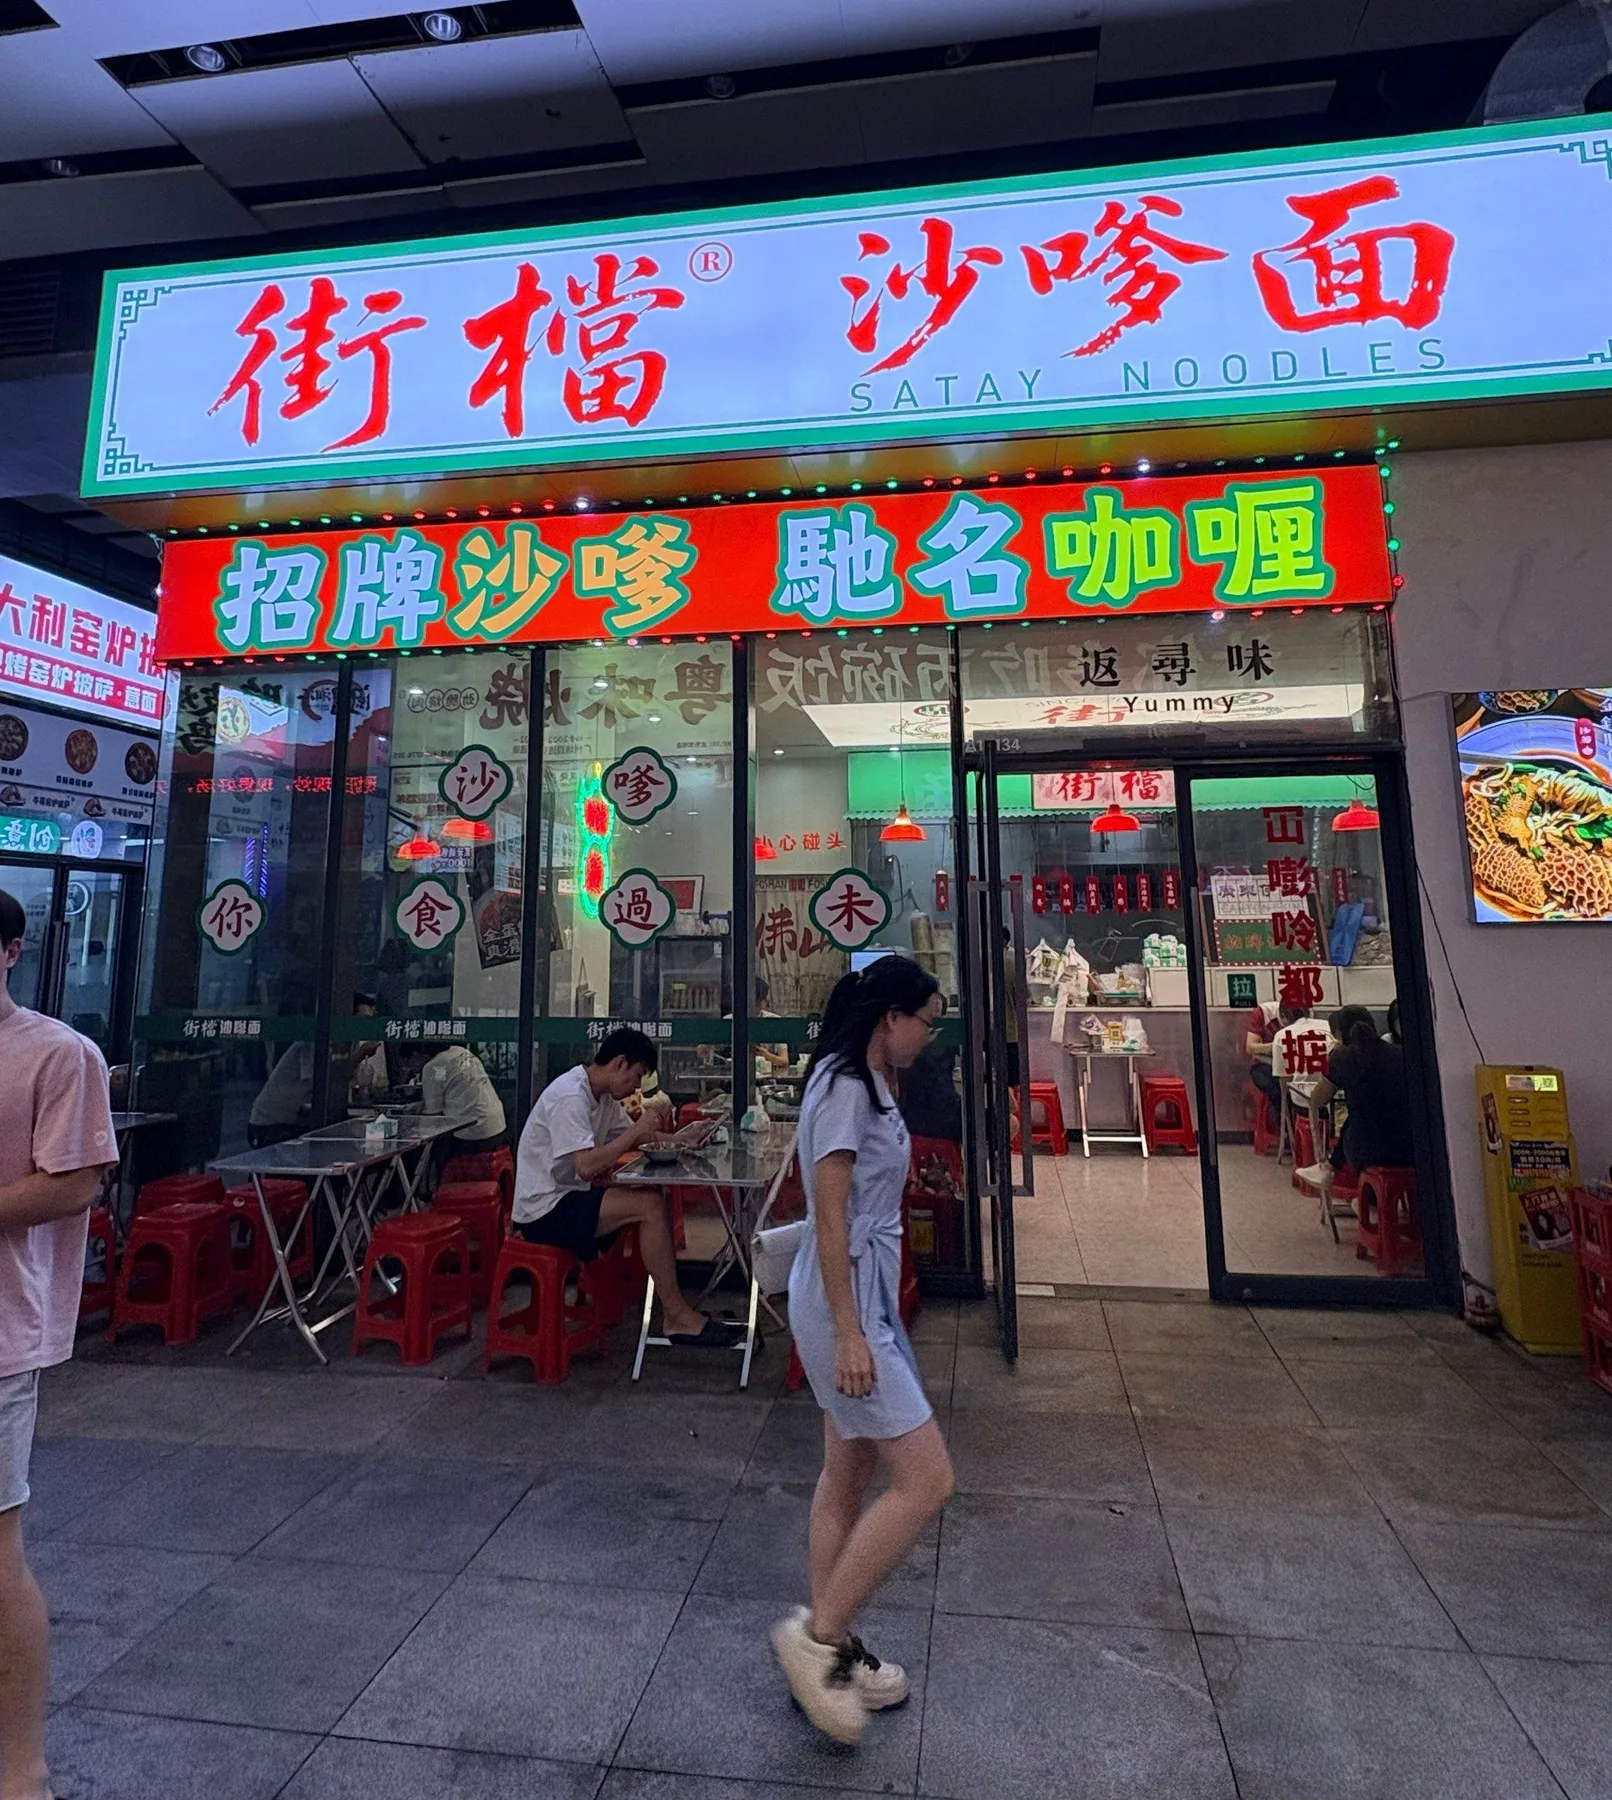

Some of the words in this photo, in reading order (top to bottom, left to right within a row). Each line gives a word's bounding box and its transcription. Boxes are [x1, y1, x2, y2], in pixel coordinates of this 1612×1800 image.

[206, 252, 686, 453] 街檔
[840, 174, 1456, 378] 沙嗲面
[849, 368, 1043, 414] SATAY
[1123, 338, 1446, 393] NOODLES
[217, 519, 694, 649] 招牌沙嗲
[776, 484, 1329, 618] 馳名咖喱
[1078, 638, 1275, 688] 返尋味
[1122, 695, 1235, 715] Yummy
[455, 761, 500, 804] 沙
[613, 763, 664, 808] 嗲
[208, 895, 254, 941] 你
[404, 891, 453, 938] 食
[612, 887, 659, 932] 過
[826, 883, 880, 933] 未
[1232, 976, 1254, 997] 拉
